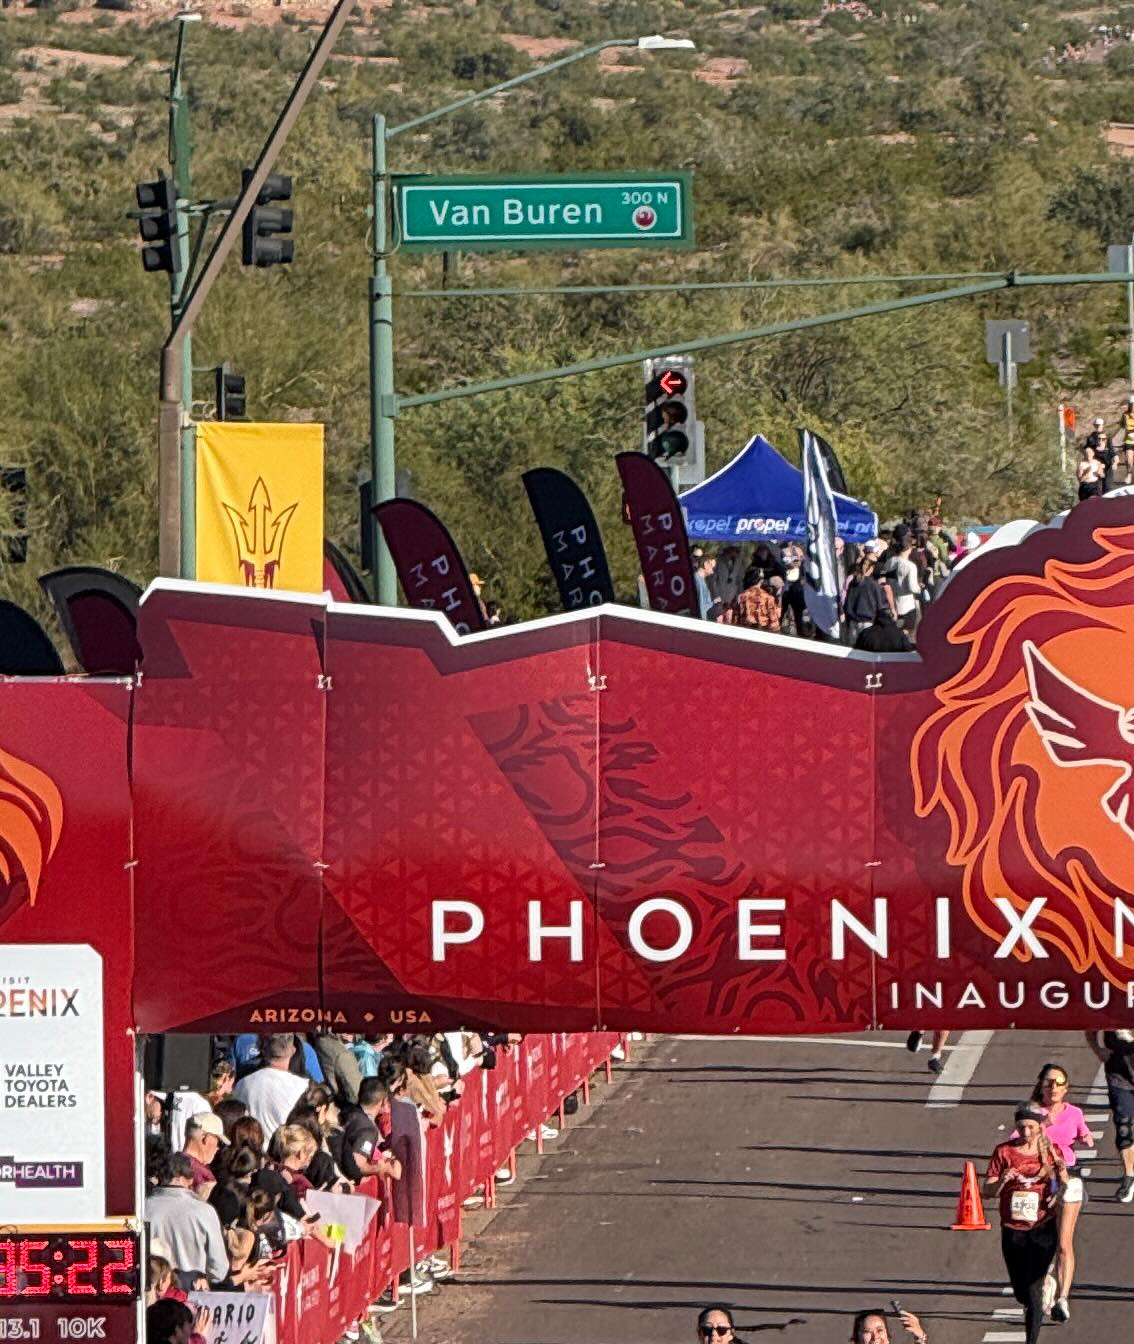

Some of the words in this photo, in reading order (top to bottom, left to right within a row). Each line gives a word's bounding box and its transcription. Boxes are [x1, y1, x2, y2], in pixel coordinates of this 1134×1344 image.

[621, 191, 652, 205] 300
[657, 191, 669, 205] N
[430, 199, 490, 226] Van
[504, 199, 602, 225] Buren
[688, 516, 732, 532] ropel
[736, 516, 791, 535] propel
[431, 896, 1050, 963] PHOENIX
[1, 976, 30, 985] ISIT
[0, 989, 80, 1017] ENIX
[249, 1009, 347, 1023] ARIZONA
[390, 1010, 432, 1023] USA
[5, 1064, 64, 1077] VALLEY
[4, 1079, 69, 1093] TOYOTA
[5, 1094, 77, 1108] DEALERS
[0, 1318, 40, 1339] 13.1
[57, 1316, 107, 1339] 10K
